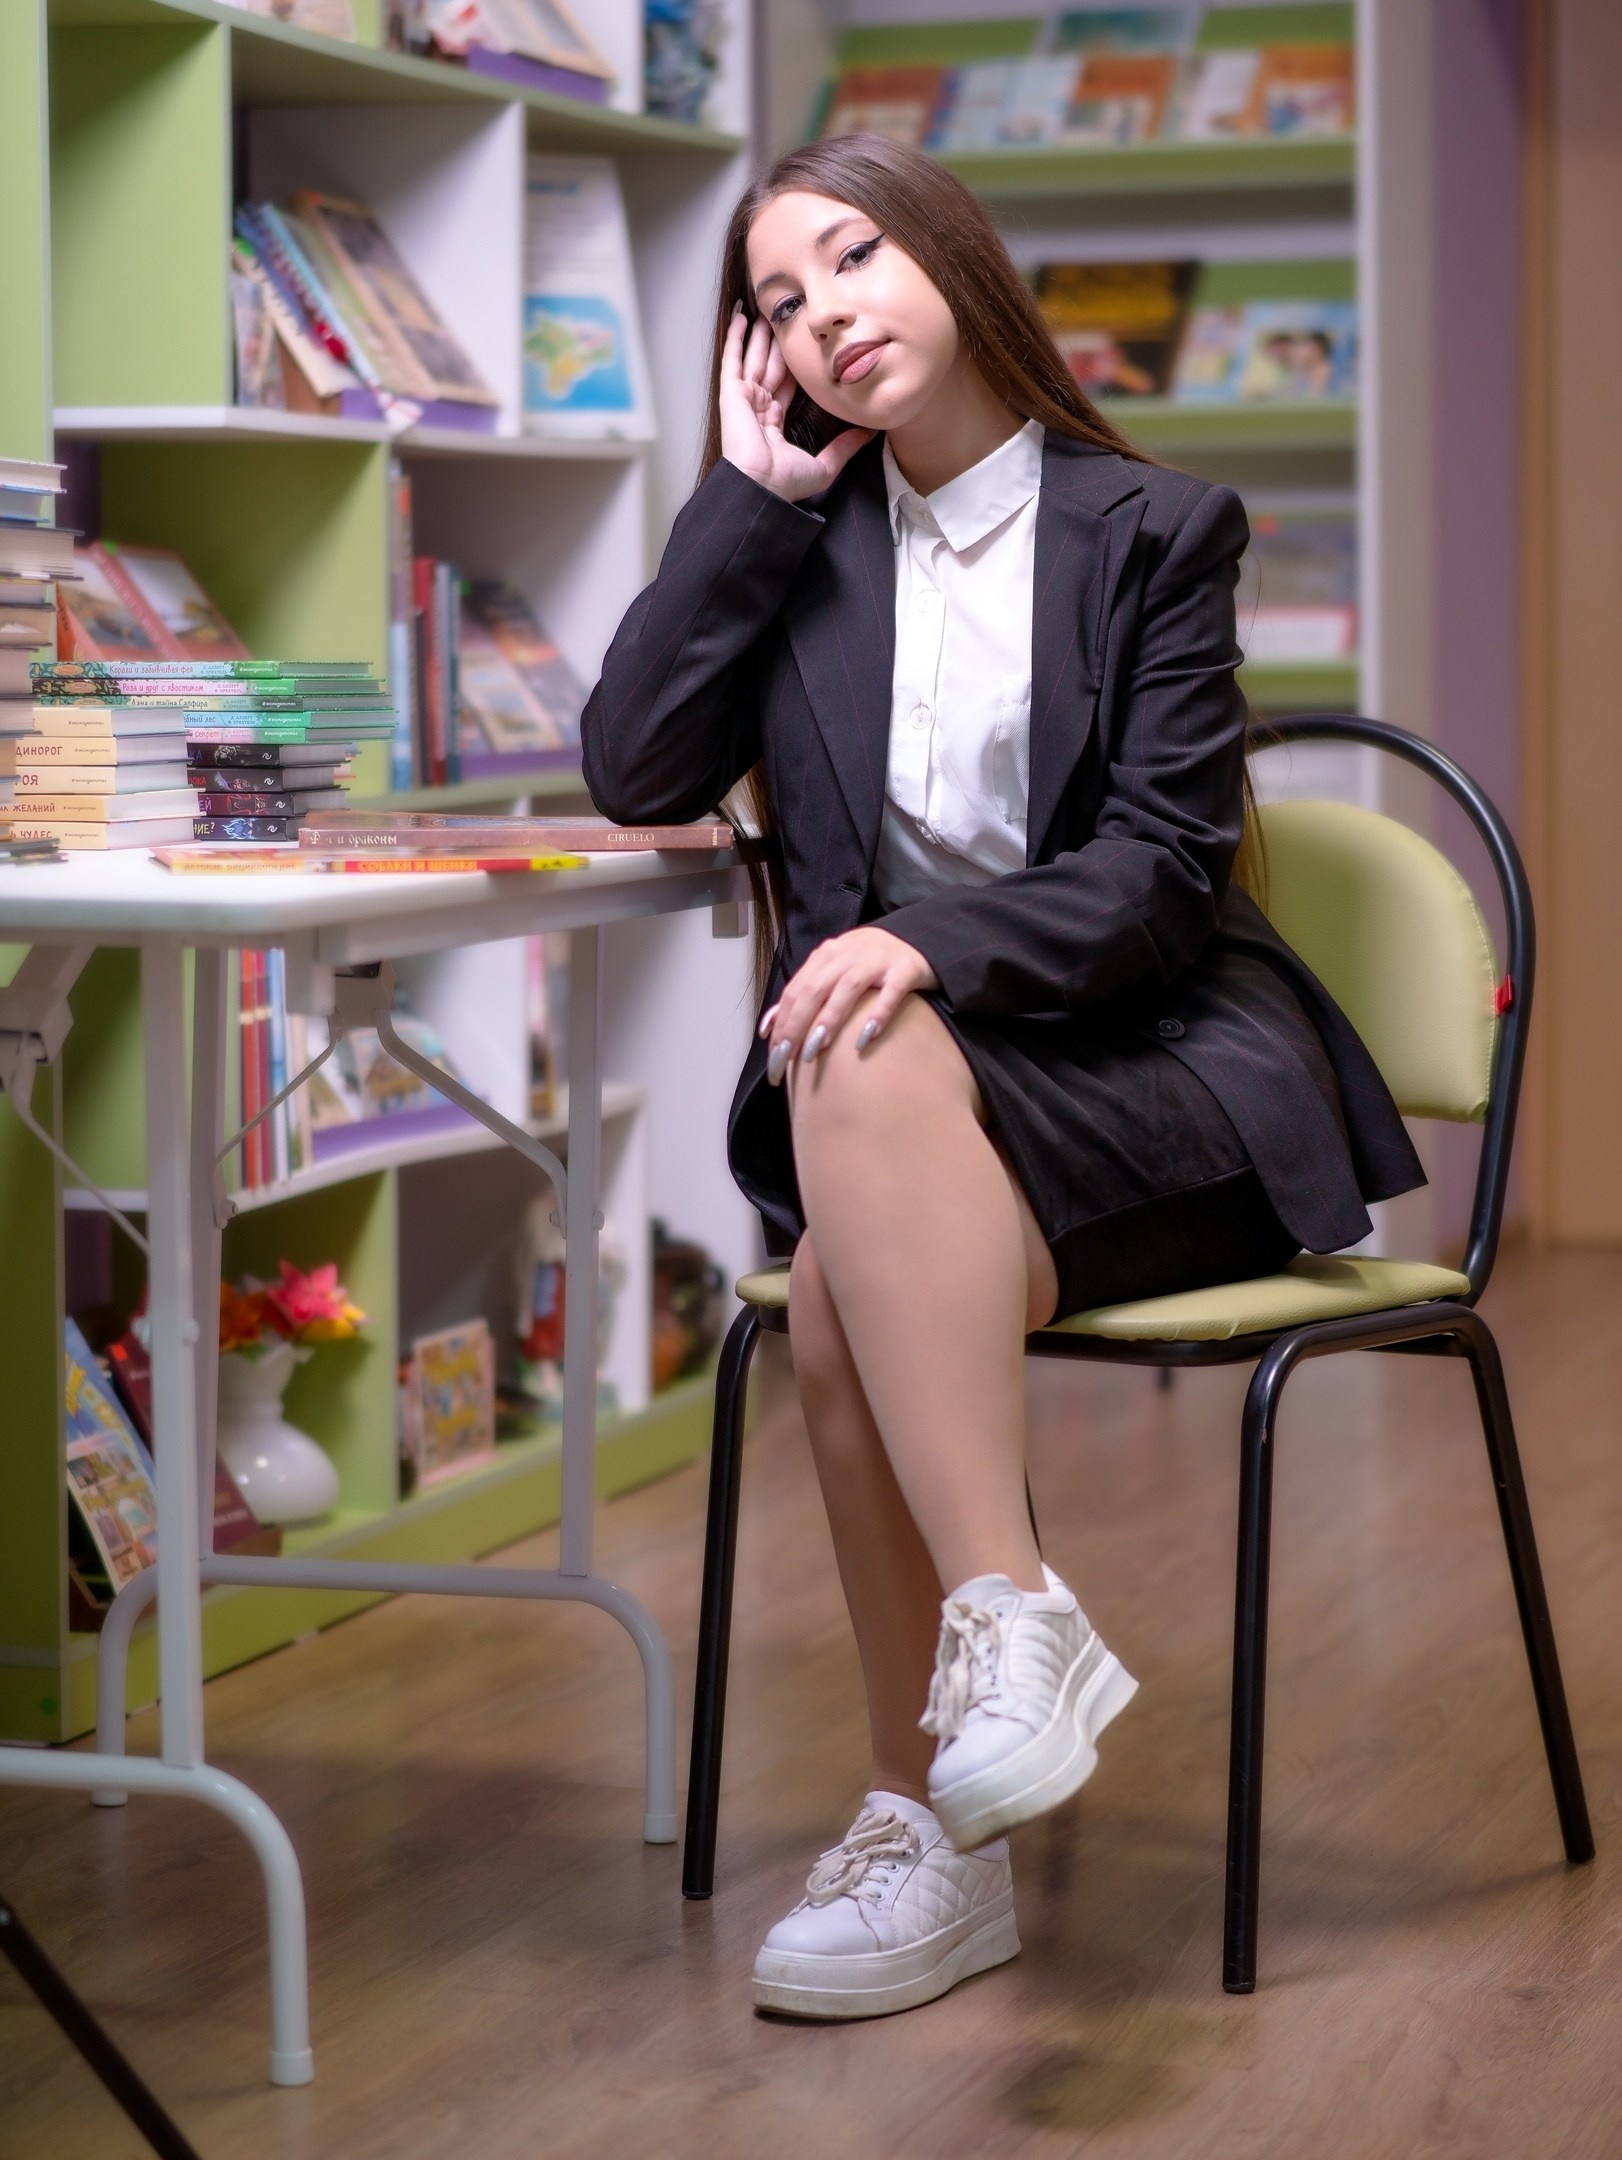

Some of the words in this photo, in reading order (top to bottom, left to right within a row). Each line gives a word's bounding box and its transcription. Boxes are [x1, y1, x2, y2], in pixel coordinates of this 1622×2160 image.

[109, 665, 133, 675] Корали
[141, 664, 179, 674] забывчивая
[181, 665, 193, 675] фея
[122, 683, 138, 692] Роза
[145, 685, 159, 694] друг
[167, 683, 204, 692] хвостиком
[178, 699, 208, 710] Сапфира
[194, 730, 220, 740] секрет
[13, 803, 56, 813] ЖЕЛАНИЙ
[337, 835, 344, 844] и
[348, 834, 398, 848] драконы
[607, 833, 655, 842] CIRUELO
[357, 860, 412, 873] СОБАКИ
[415, 860, 425, 873] И
[428, 859, 478, 872] ЩЕНКИ
